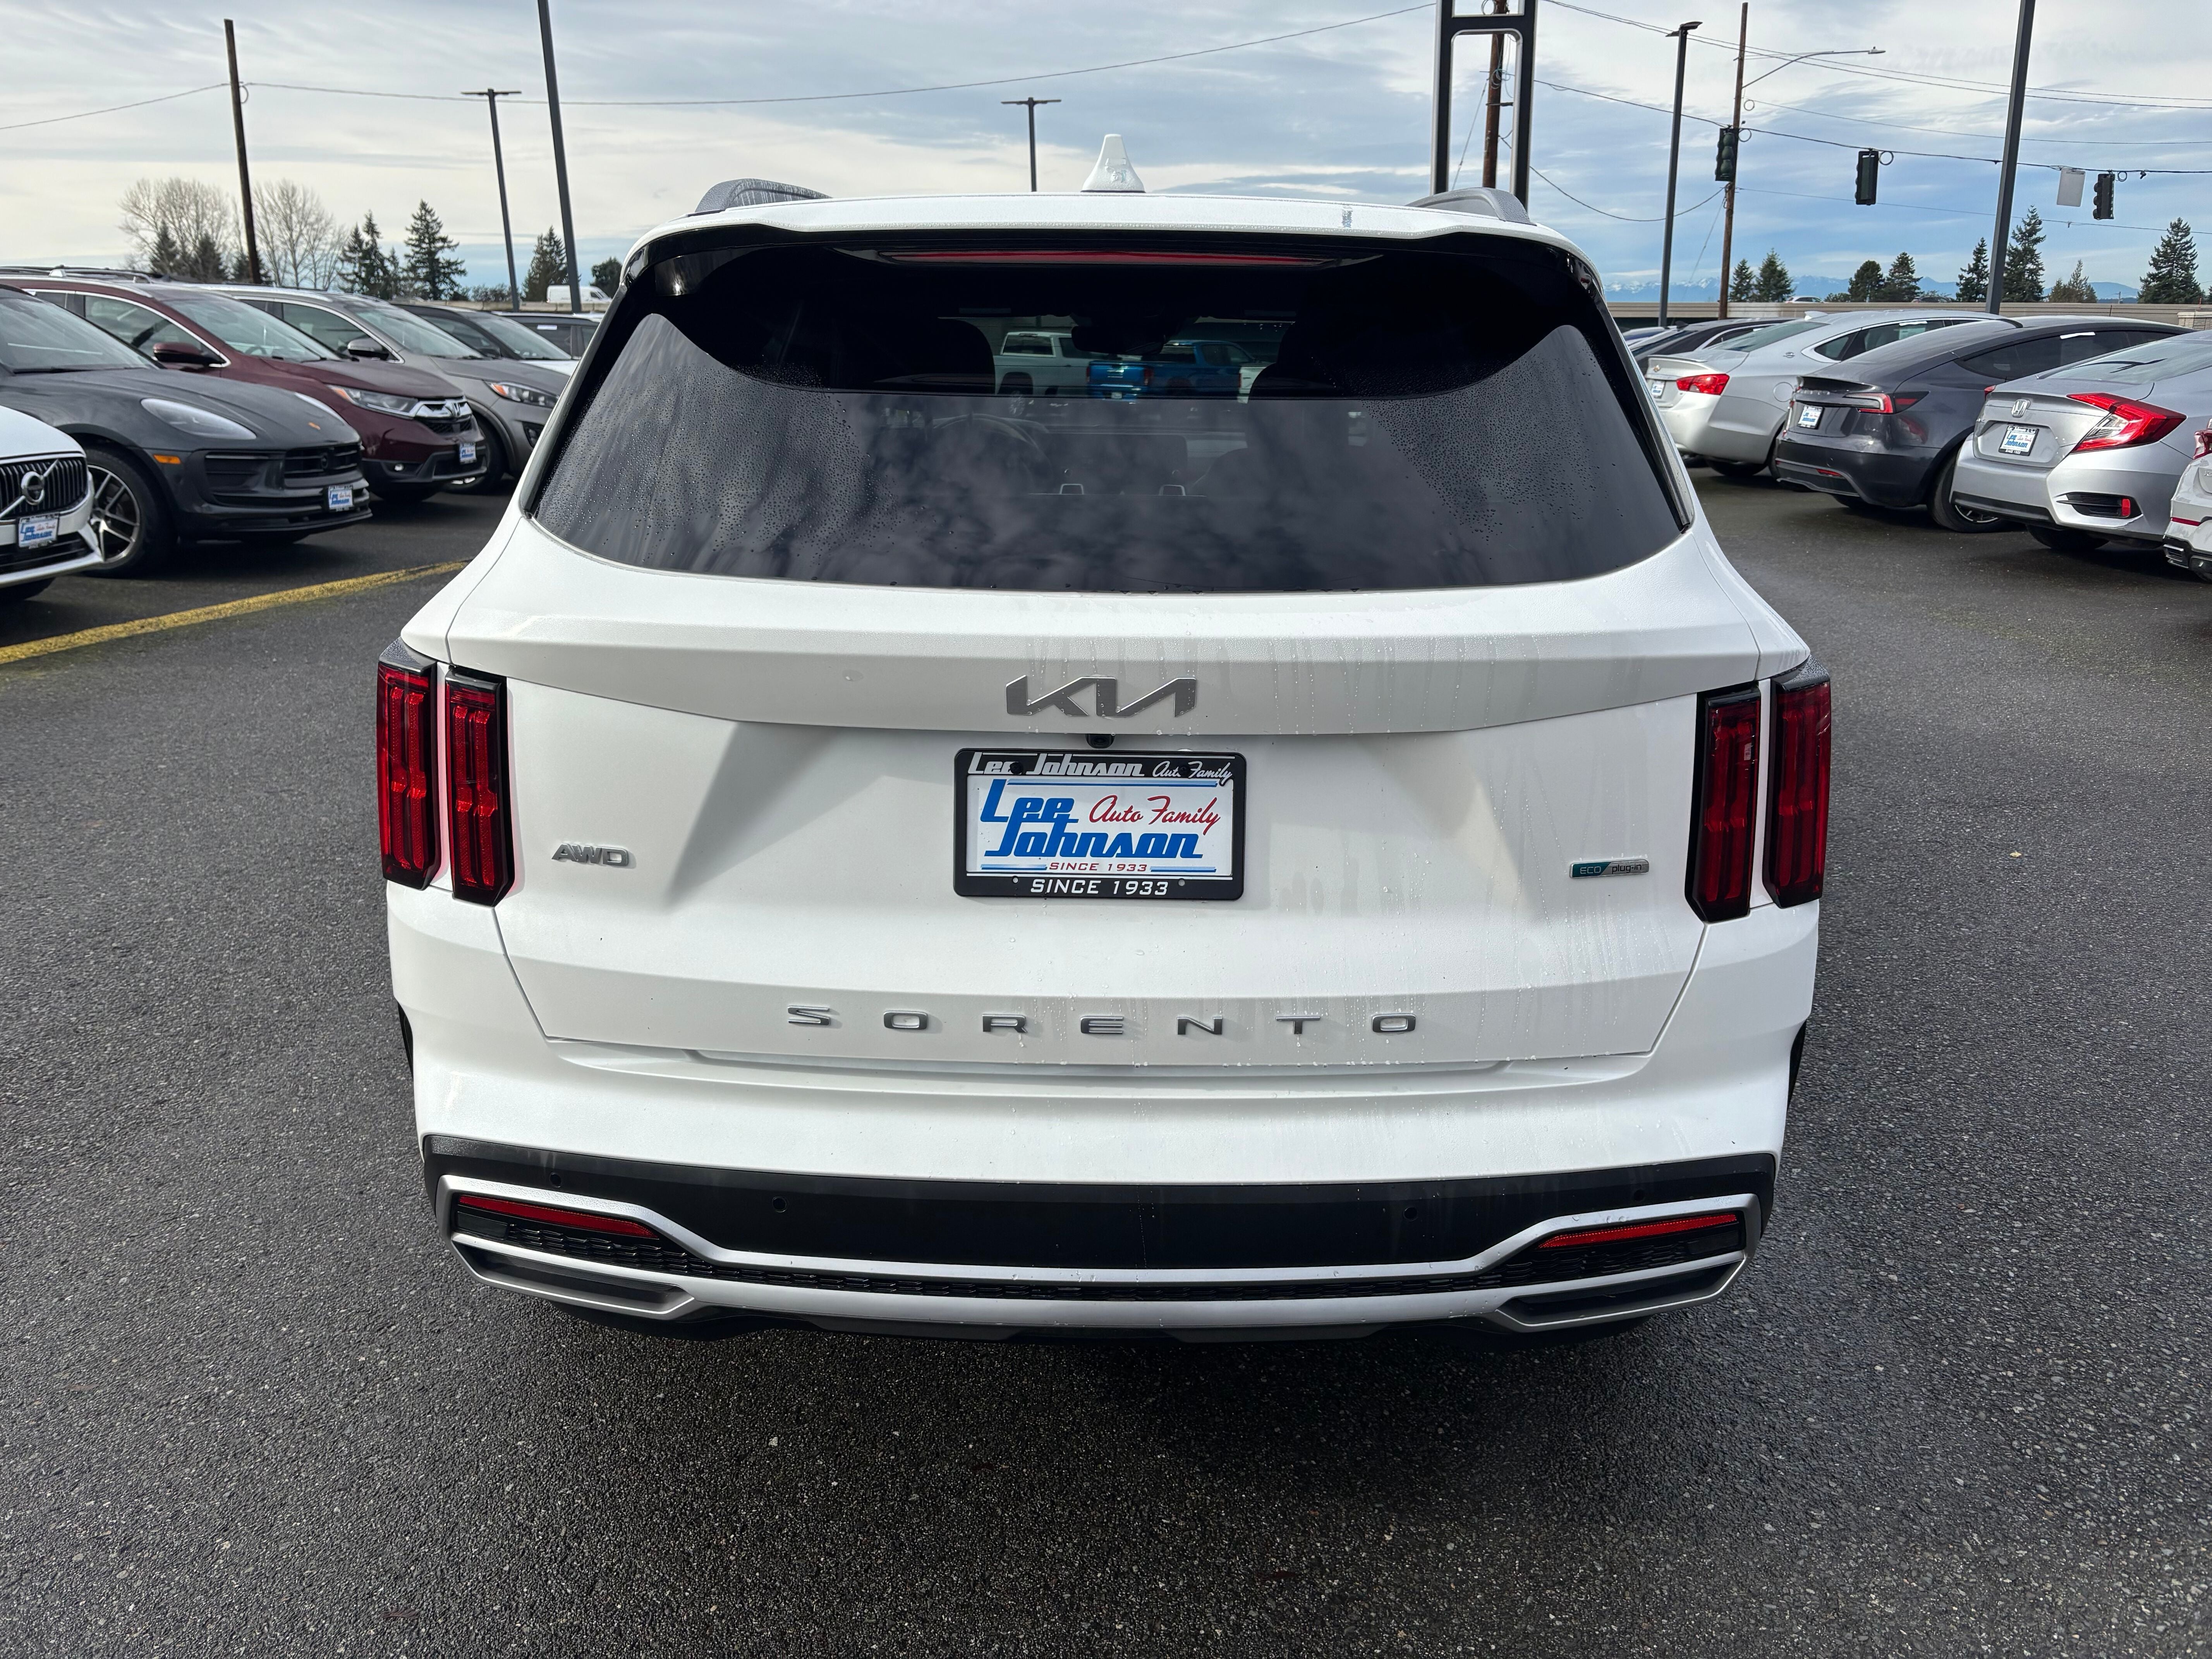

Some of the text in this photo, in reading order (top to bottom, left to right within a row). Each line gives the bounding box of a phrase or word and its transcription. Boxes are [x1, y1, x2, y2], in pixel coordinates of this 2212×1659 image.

[1006, 675, 1197, 718] KIA
[1026, 753, 1145, 776] Johnson
[1152, 761, 1182, 777] Aut
[1187, 761, 1232, 785] Family
[980, 779, 1079, 823] Lee
[1089, 795, 1221, 836] Auto Family
[551, 843, 629, 866] AWD
[984, 822, 1203, 859] Johnson
[1049, 862, 1147, 872] SINCE 1933
[1580, 863, 1642, 874] ECO plug-in
[1031, 879, 1168, 895] SINCE 1933
[788, 1005, 1417, 1035] SORENTO
